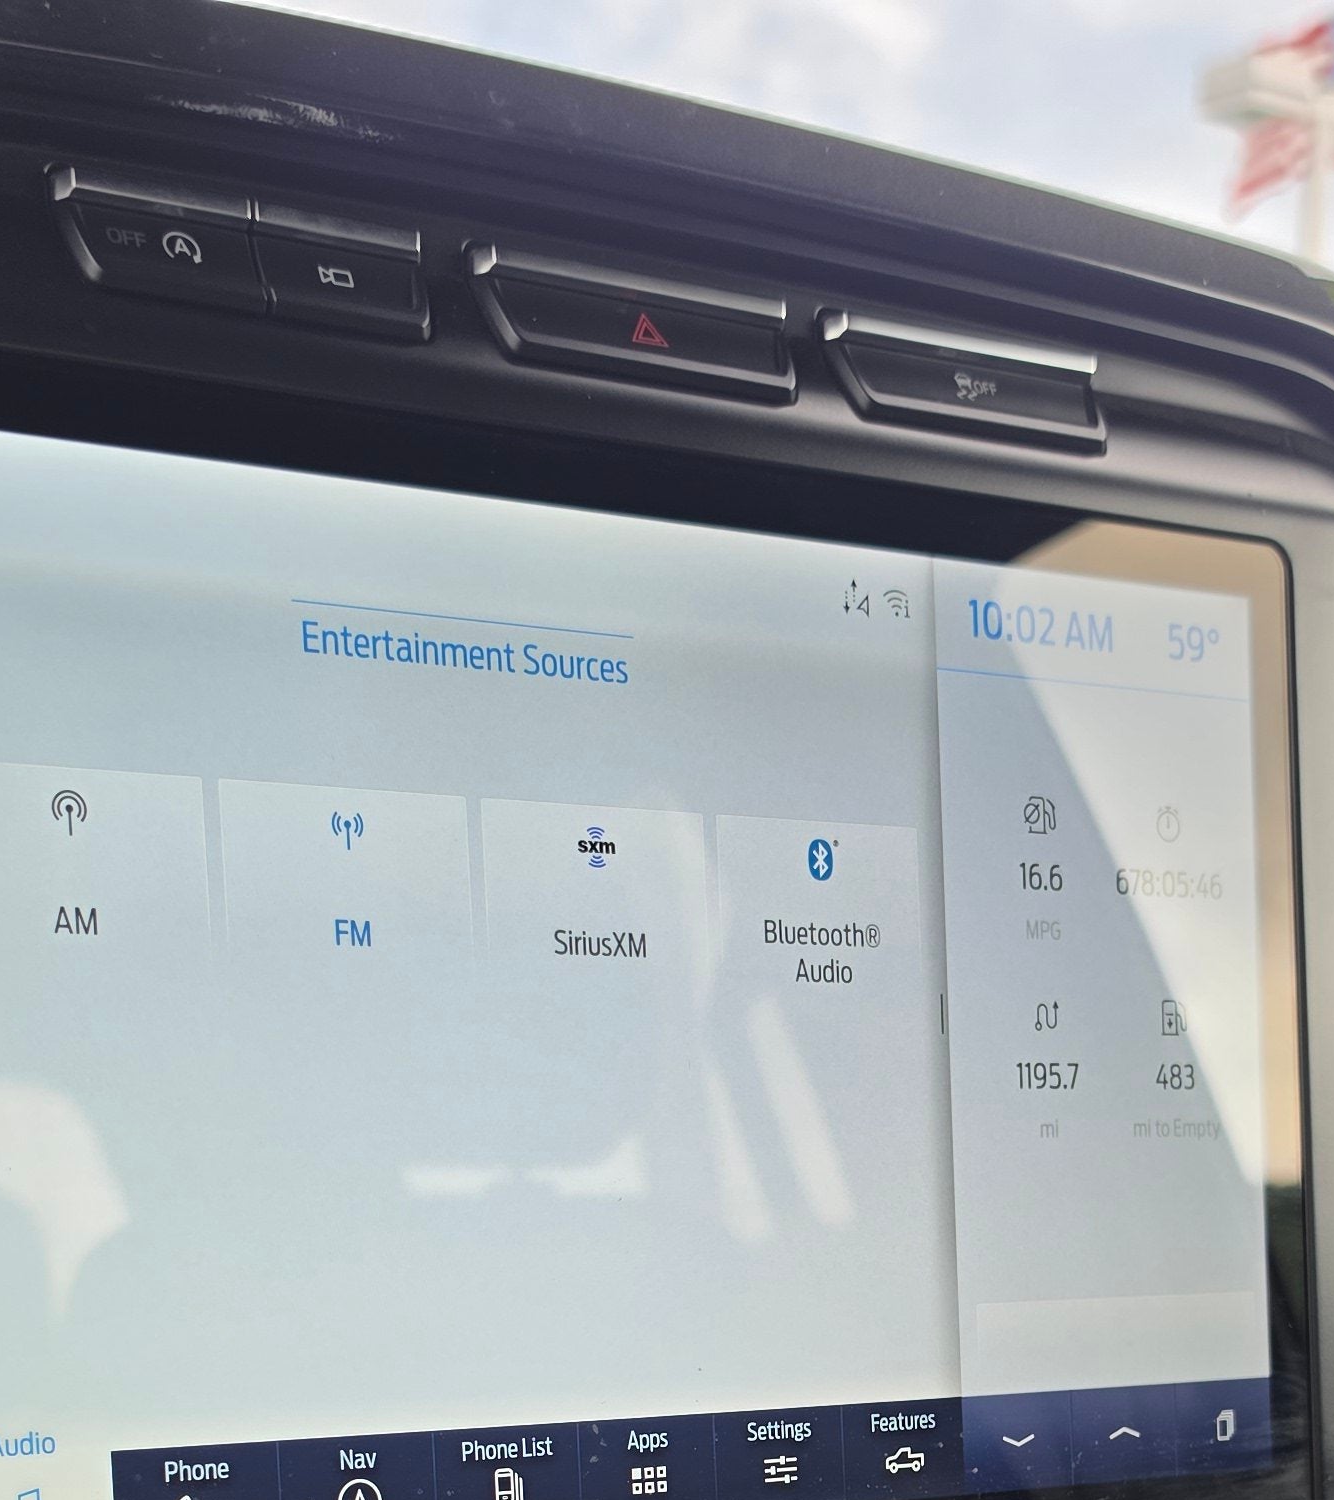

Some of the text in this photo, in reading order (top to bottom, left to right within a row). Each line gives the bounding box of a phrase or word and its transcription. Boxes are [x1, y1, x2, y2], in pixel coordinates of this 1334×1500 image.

[107, 227, 147, 249] OFF
[973, 380, 997, 397] OFF
[967, 599, 1115, 655] 10:02 AM
[301, 620, 629, 686] Entertainment Sources
[1167, 623, 1220, 662] 59°
[578, 840, 616, 854] sxm
[1019, 862, 1064, 893] 16.6
[1116, 868, 1223, 900] 678:05:46
[54, 907, 99, 937] AM
[334, 920, 372, 948] FM
[1025, 920, 1062, 941] MPG
[554, 930, 647, 960] SiriusXM
[795, 957, 853, 985] Audio
[1016, 1062, 1079, 1091] 1195.7
[1155, 1063, 1195, 1091] 483
[1040, 1118, 1059, 1138] mi
[1133, 1118, 1220, 1140] mi to Empty
[746, 1418, 812, 1444] Settings
[870, 1411, 936, 1434] Features
[461, 1436, 554, 1463] Phone List
[627, 1428, 669, 1451] Apps
[164, 1458, 230, 1483] Phone
[339, 1448, 378, 1471] Nav
